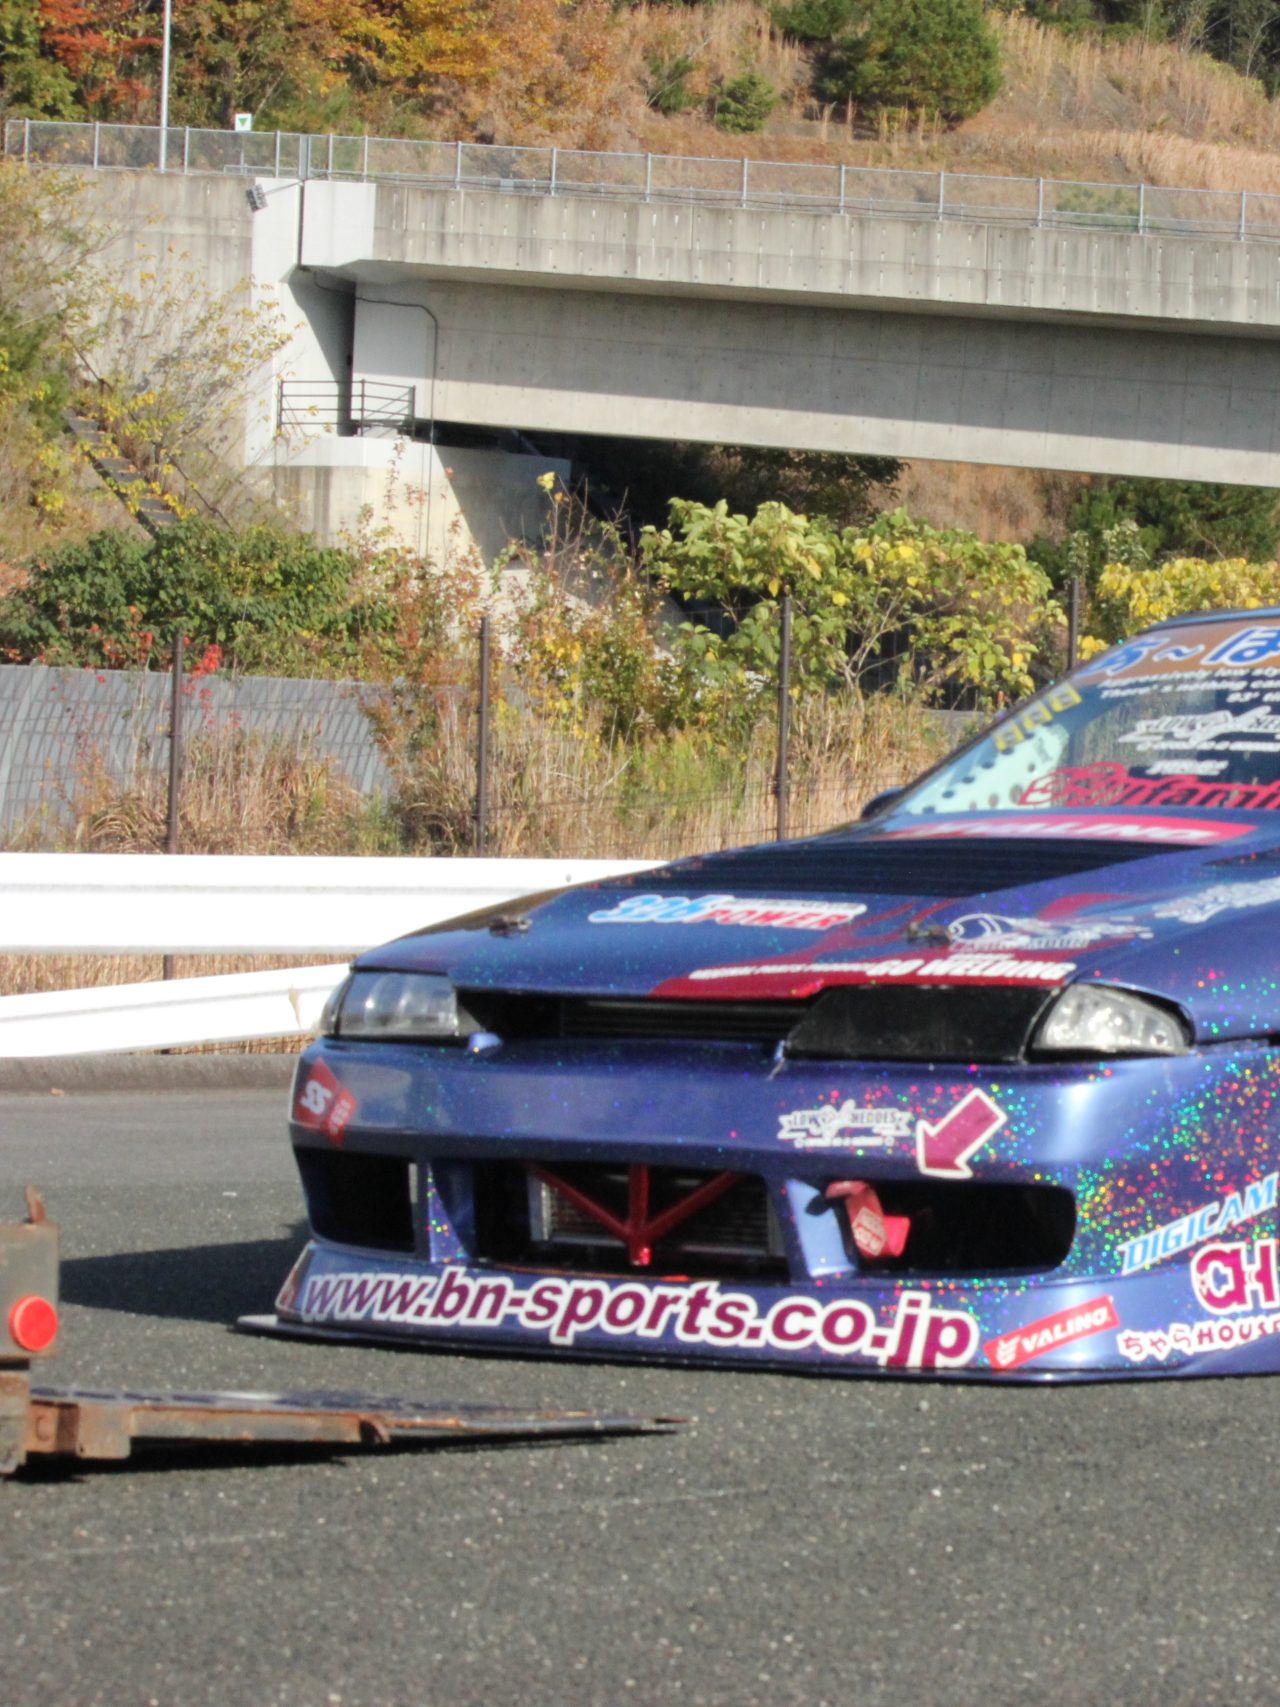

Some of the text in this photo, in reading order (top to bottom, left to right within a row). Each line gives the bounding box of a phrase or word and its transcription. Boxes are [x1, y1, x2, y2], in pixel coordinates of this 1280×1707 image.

[866, 958, 924, 976] GO
[917, 959, 1077, 980] WELDING
[1116, 1172, 1280, 1276] DIGICAM
[300, 1266, 980, 1368] www.bn-sports.co.jp
[1020, 1305, 1111, 1352] VALINO
